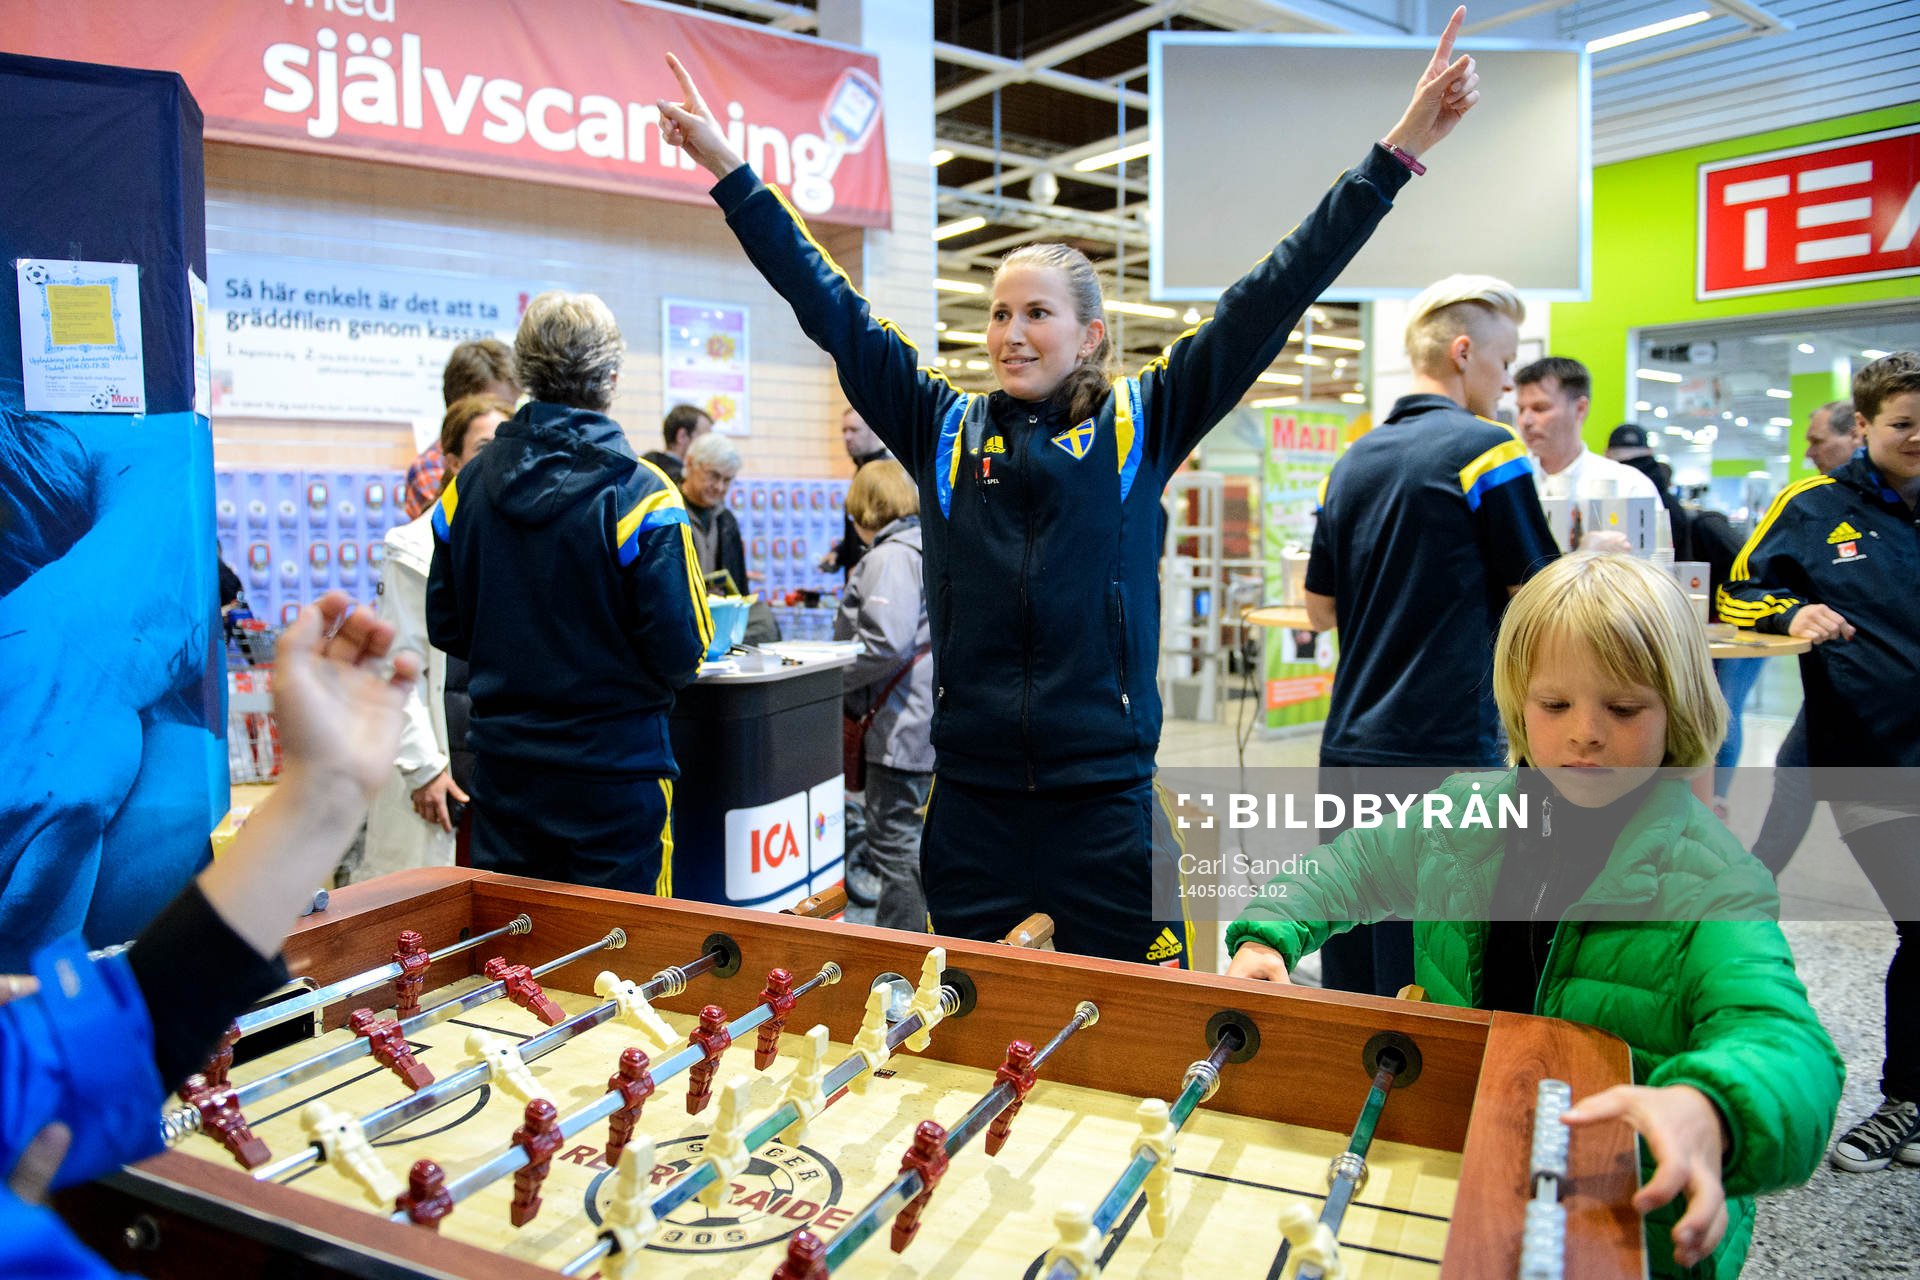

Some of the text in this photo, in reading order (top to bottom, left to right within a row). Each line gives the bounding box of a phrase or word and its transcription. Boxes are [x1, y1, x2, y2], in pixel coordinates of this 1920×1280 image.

[226, 279, 498, 319] Så här enkelt är det att ta
[227, 308, 341, 333] gräddfilen
[349, 319, 421, 340] genom
[751, 820, 800, 874] ICA
